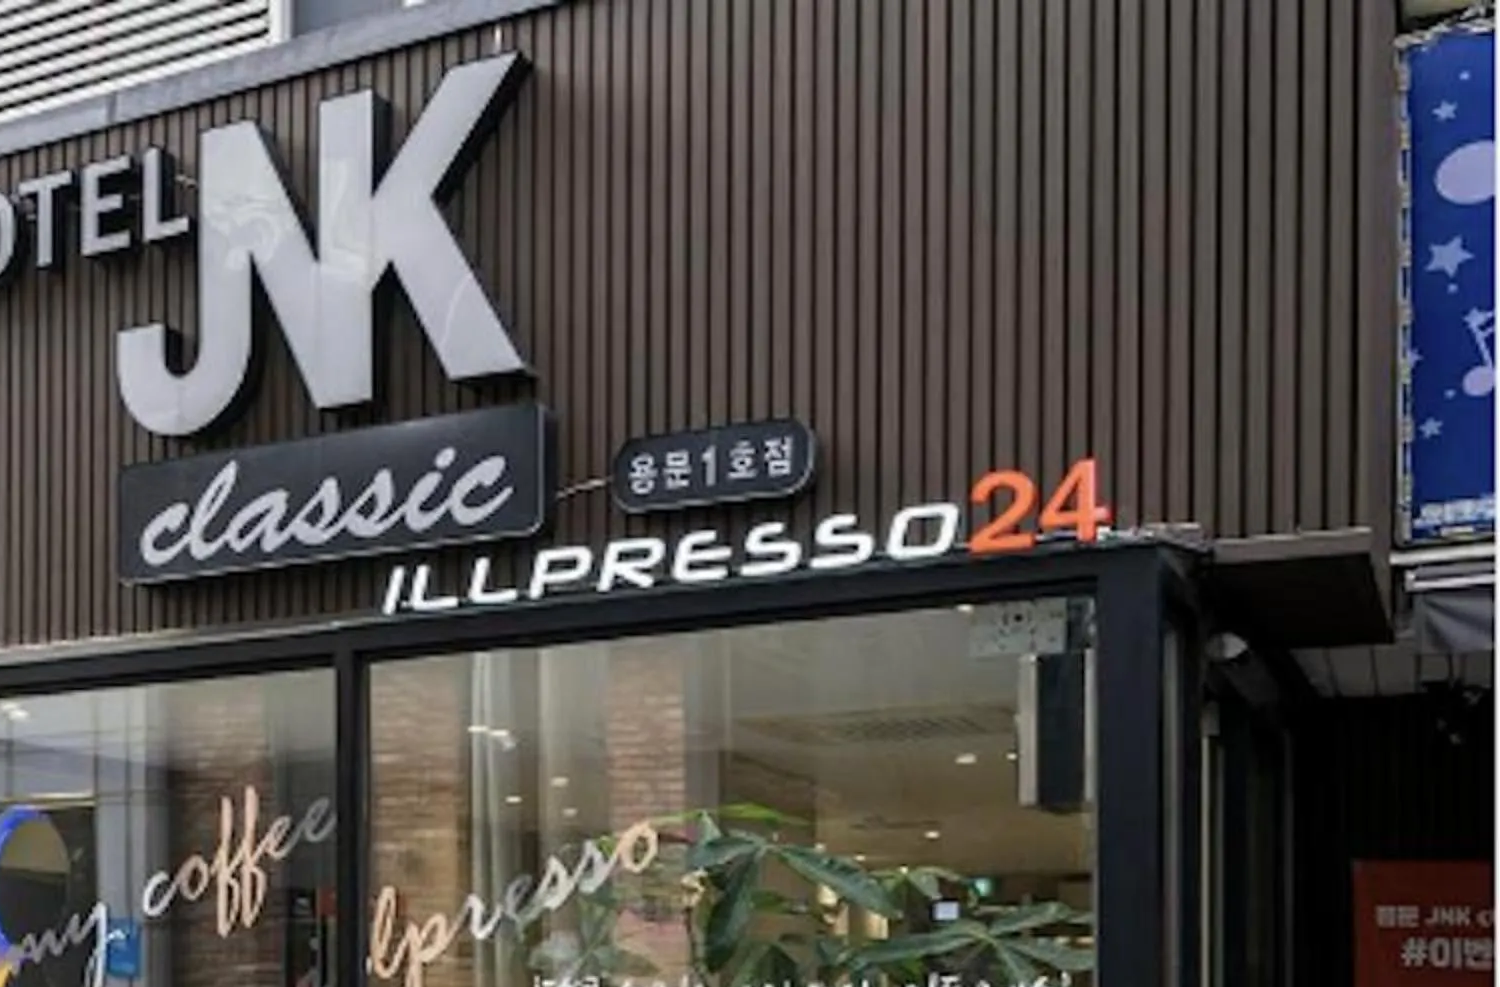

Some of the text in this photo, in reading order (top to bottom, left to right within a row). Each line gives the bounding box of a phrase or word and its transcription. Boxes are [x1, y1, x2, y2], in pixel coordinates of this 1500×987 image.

[116, 50, 528, 436] JNK
[140, 447, 513, 566] classic
[142, 785, 337, 938] coffee
